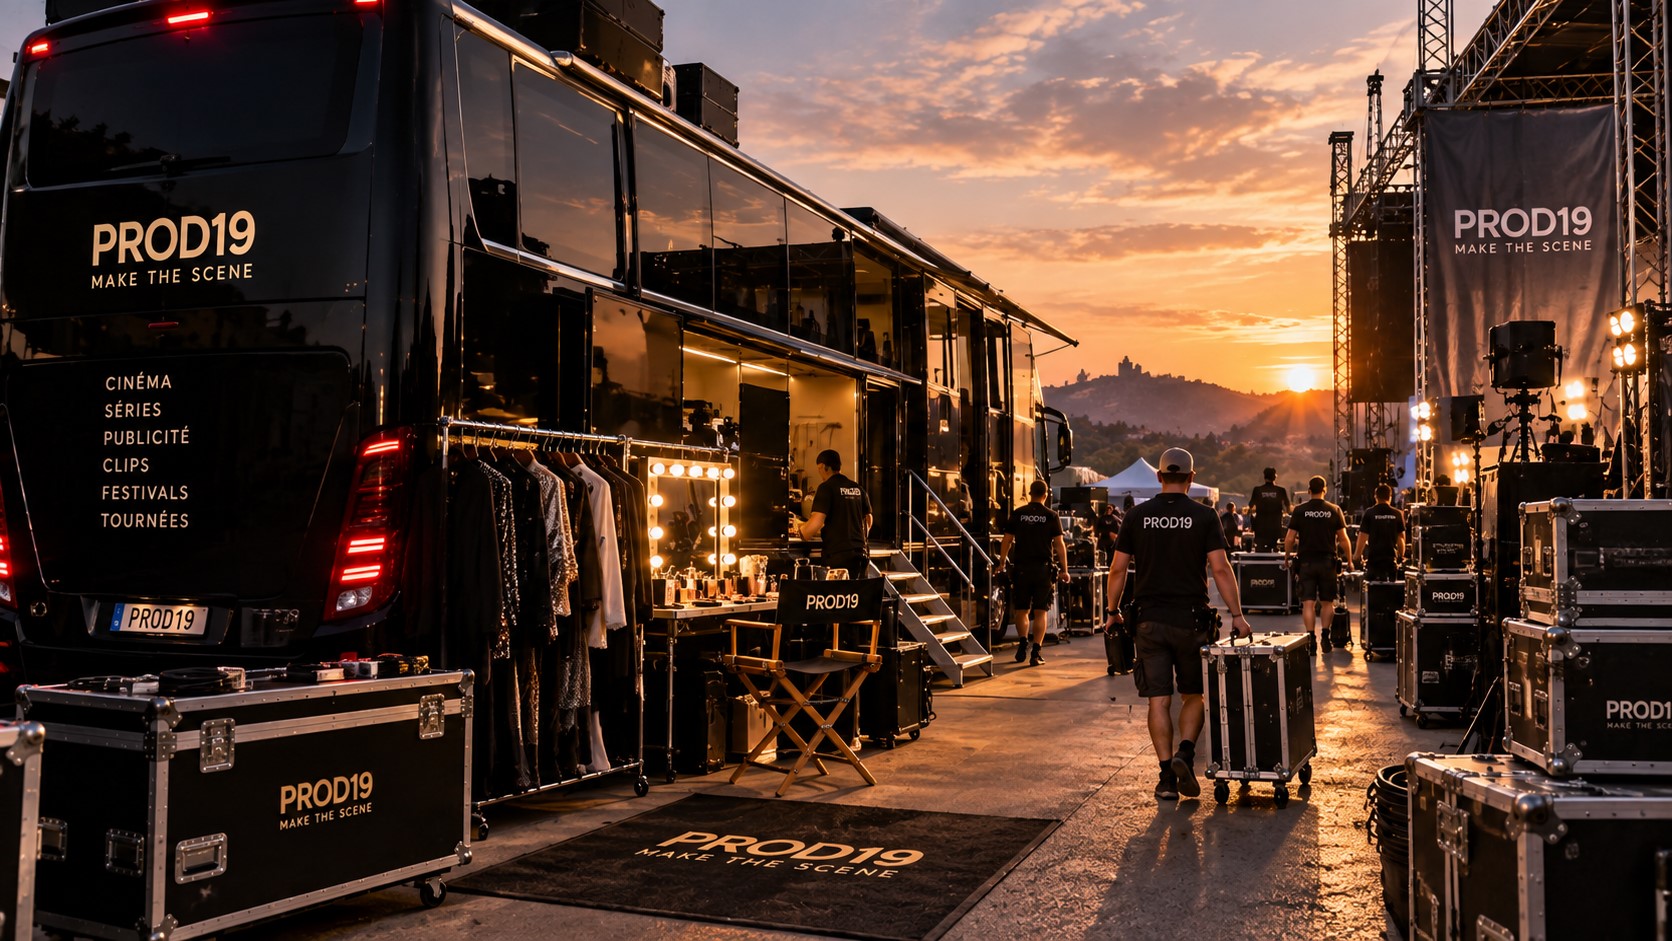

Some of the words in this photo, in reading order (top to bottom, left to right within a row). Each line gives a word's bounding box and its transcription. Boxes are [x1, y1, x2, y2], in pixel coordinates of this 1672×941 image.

[1454, 206, 1593, 239] PROD19
[92, 210, 256, 266] PROD19
[1455, 243, 1497, 255] MAKE
[1505, 241, 1534, 253] THE
[1542, 240, 1592, 253] SCENE
[91, 272, 138, 289] MAKE
[148, 268, 181, 285] THE
[191, 263, 253, 282] SCENE
[105, 372, 172, 391] CINÉMA
[104, 400, 162, 419] SÉRIES
[103, 425, 190, 446] PUBLICITÉ
[102, 457, 149, 473] CLIPS
[102, 485, 189, 500] FESTIVALS
[100, 509, 189, 529] TOURNÉES
[1143, 516, 1193, 530] PROD19
[805, 593, 859, 610] PROD19
[128, 607, 195, 630] PROD19
[1635, 722, 1652, 730] THE
[280, 771, 374, 815] PROD19
[280, 815, 310, 831] MAKE
[314, 810, 335, 823] THE
[339, 802, 372, 818] SCENE
[656, 831, 924, 868] PROD19
[634, 848, 715, 863] MAKE
[726, 856, 785, 868] THE
[793, 862, 899, 879] SCENE
